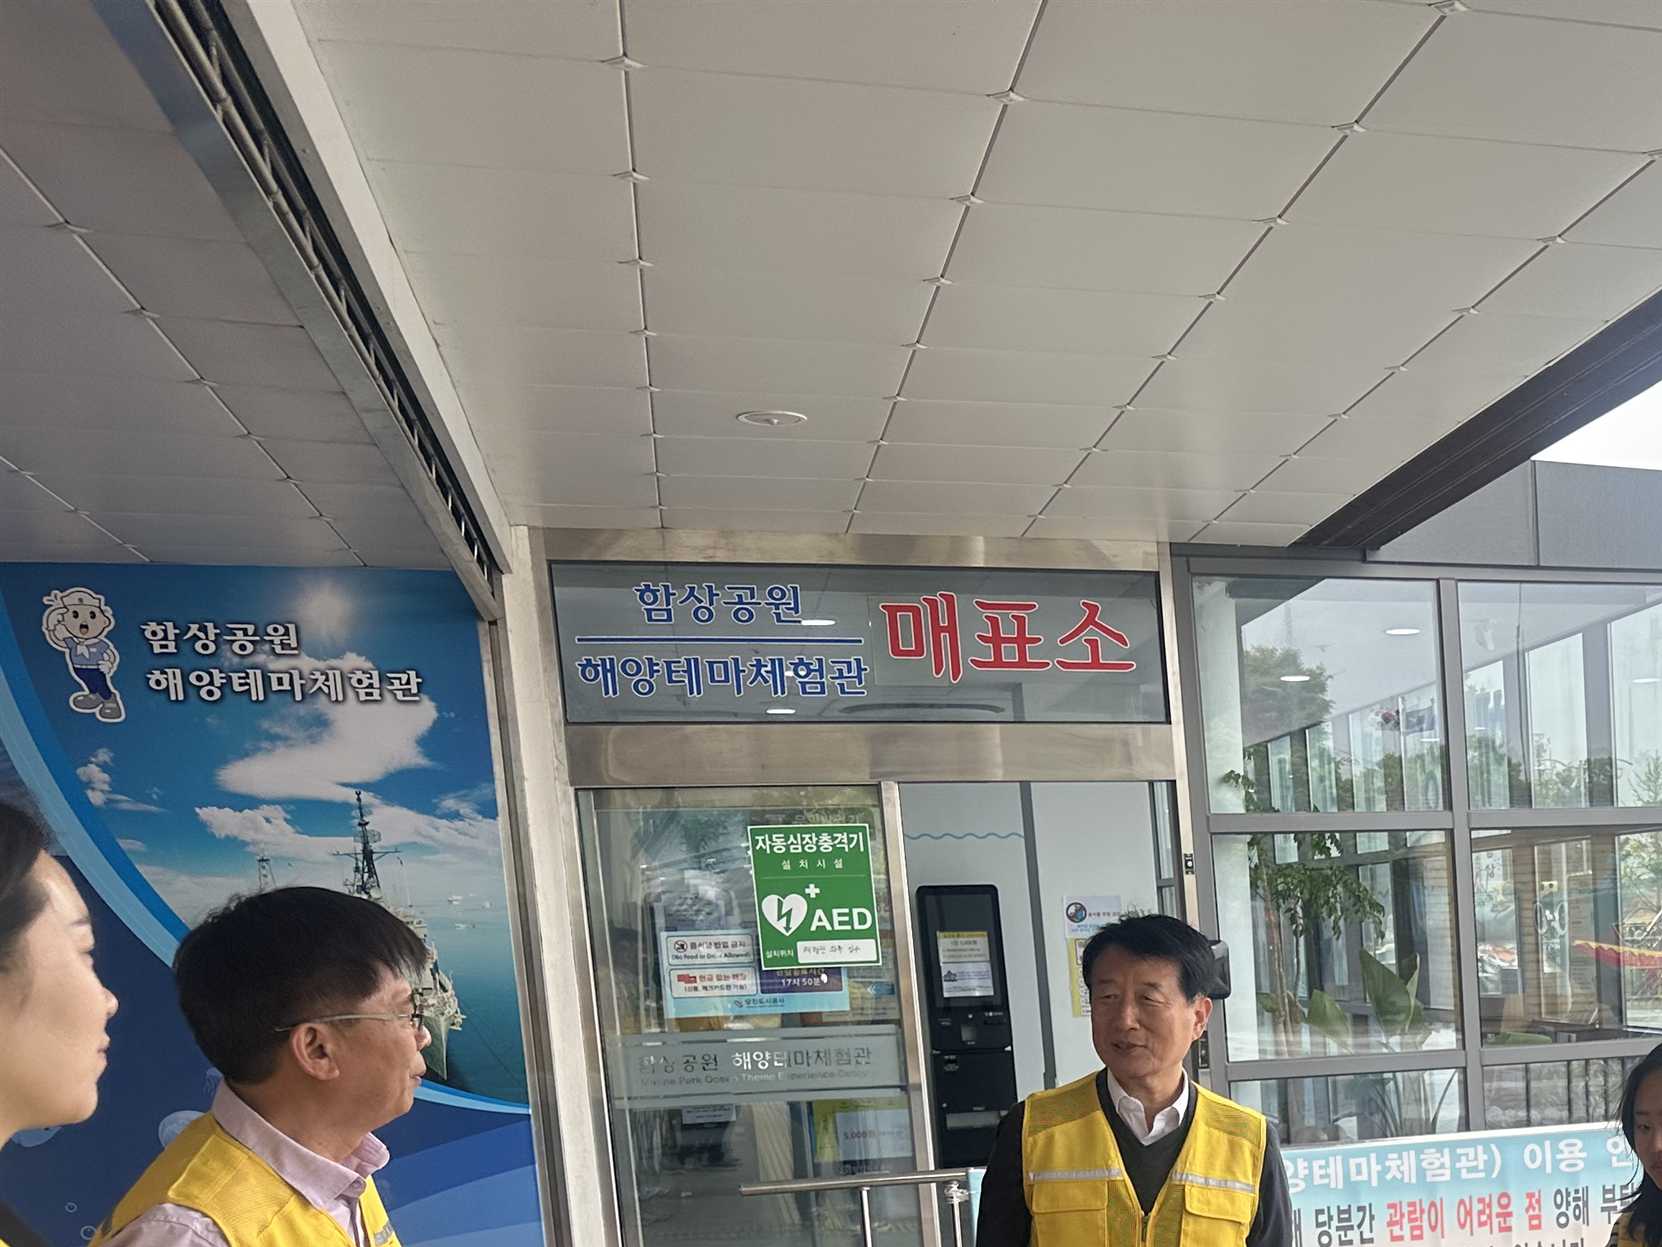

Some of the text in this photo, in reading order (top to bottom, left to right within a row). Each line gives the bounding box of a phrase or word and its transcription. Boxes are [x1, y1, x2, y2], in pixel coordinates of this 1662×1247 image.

[634, 582, 802, 627] 함상공원
[141, 622, 299, 655] 함상공원
[879, 591, 1136, 684] 매표소
[147, 668, 422, 702] 해양테마체험관
[576, 656, 870, 699] 해양테마체험관
[755, 832, 865, 854] 자동심장충격기
[810, 907, 873, 932] AED
[732, 1047, 872, 1071] 해양테마체험관
[1523, 1138, 1588, 1175] 이용
[1386, 1197, 1445, 1242] 관람이
[1457, 1191, 1513, 1236] 어려운
[1525, 1188, 1543, 1231] 점
[1553, 1185, 1590, 1229] 양해
